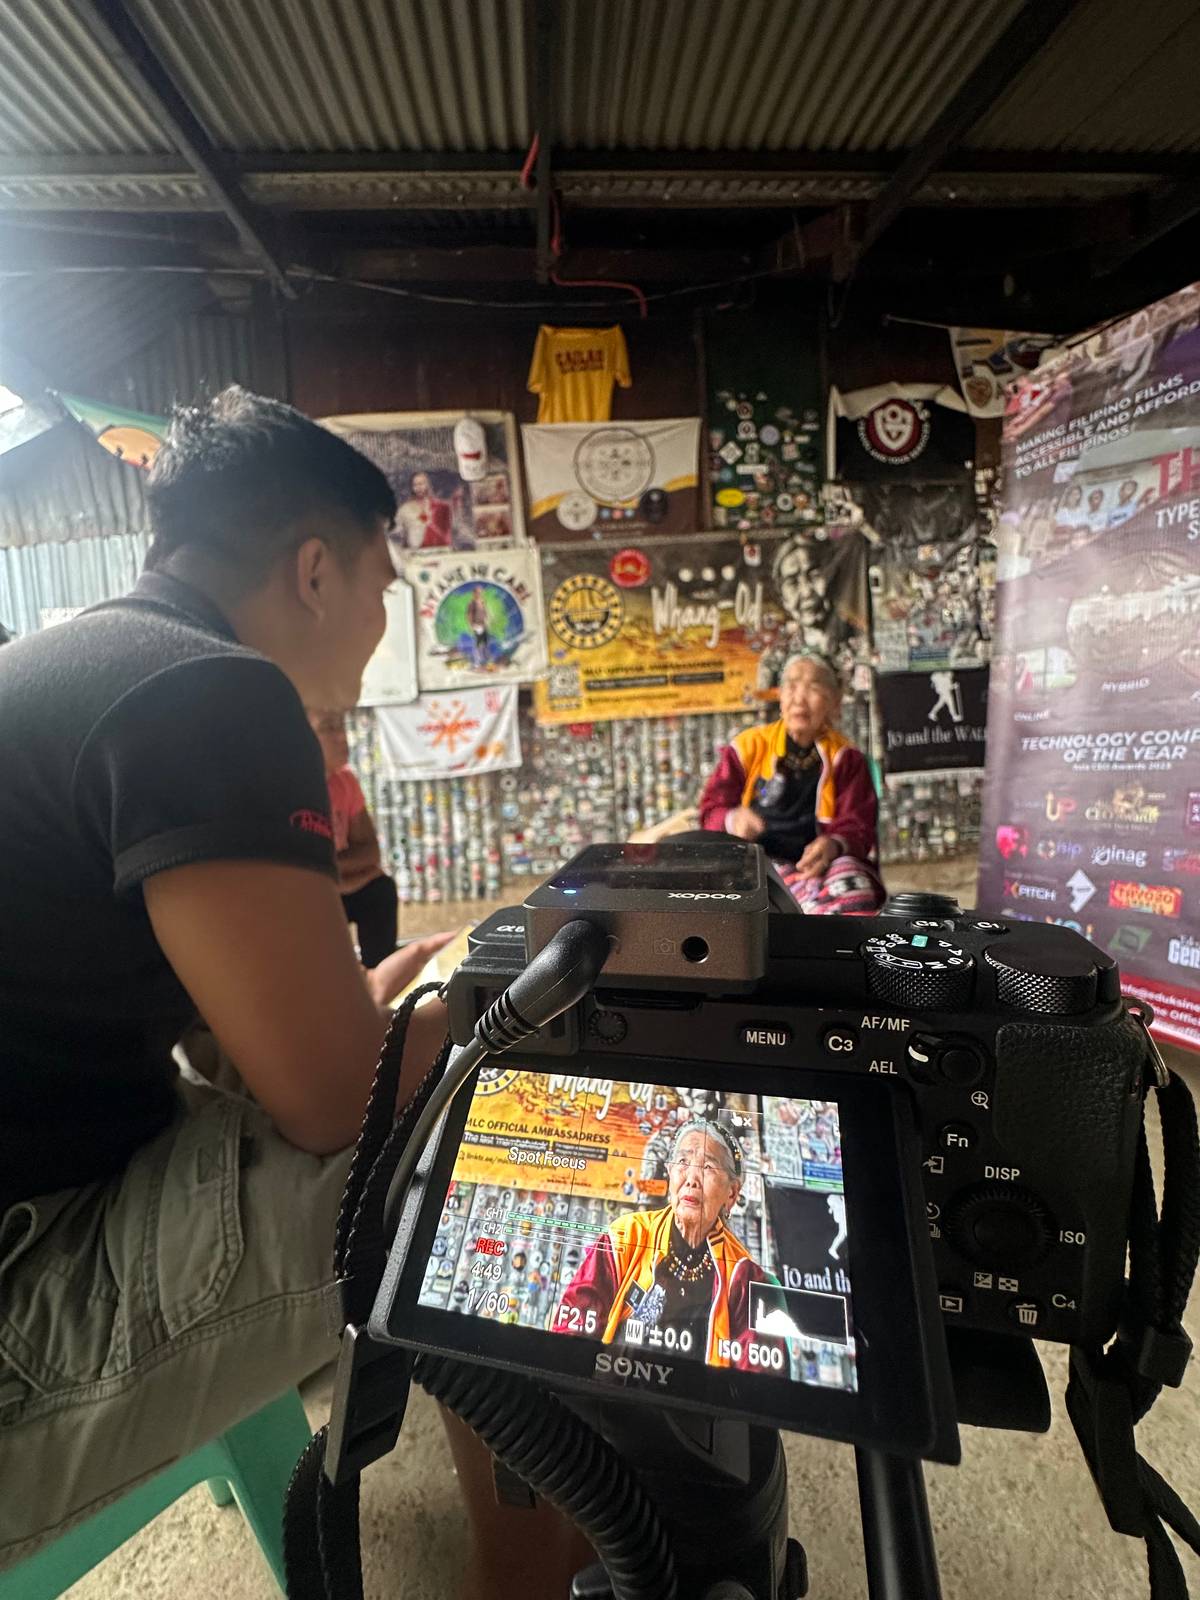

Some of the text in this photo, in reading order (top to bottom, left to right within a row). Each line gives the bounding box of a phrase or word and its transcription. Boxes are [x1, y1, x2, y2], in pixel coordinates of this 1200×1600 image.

[1015, 373, 1184, 454] MAKING FILIPINO FILMS
[1014, 426, 1094, 466] ACCESSIBLE
[1095, 410, 1130, 432] AND
[1015, 423, 1131, 480] TO ALL FILIPINOS
[1021, 731, 1137, 751] TECHNOLOGY
[1063, 745, 1188, 763] OF THE YEAR
[861, 1016, 910, 1032] AF/MF
[746, 1031, 786, 1046] MENU
[829, 1036, 853, 1052] C3
[869, 1060, 898, 1075] AEL
[487, 1121, 529, 1134] OFFICIAL
[531, 1126, 611, 1144] AMBASSADRESS
[947, 1133, 968, 1147] Fn
[508, 1147, 541, 1164] Spot
[544, 1152, 586, 1170] Focus
[984, 1165, 1020, 1181] DISP
[483, 1222, 501, 1234] CH2
[1059, 1230, 1086, 1245] ISO
[476, 1237, 504, 1256] REC
[472, 1261, 502, 1281] 4:49
[804, 1266, 832, 1292] and
[468, 1288, 509, 1314] 1/60
[1052, 1293, 1076, 1310] C4
[558, 1305, 597, 1334] F2.5
[649, 1325, 692, 1351] ±0.0
[718, 1338, 742, 1361] ISO
[595, 1353, 674, 1384] SONY
